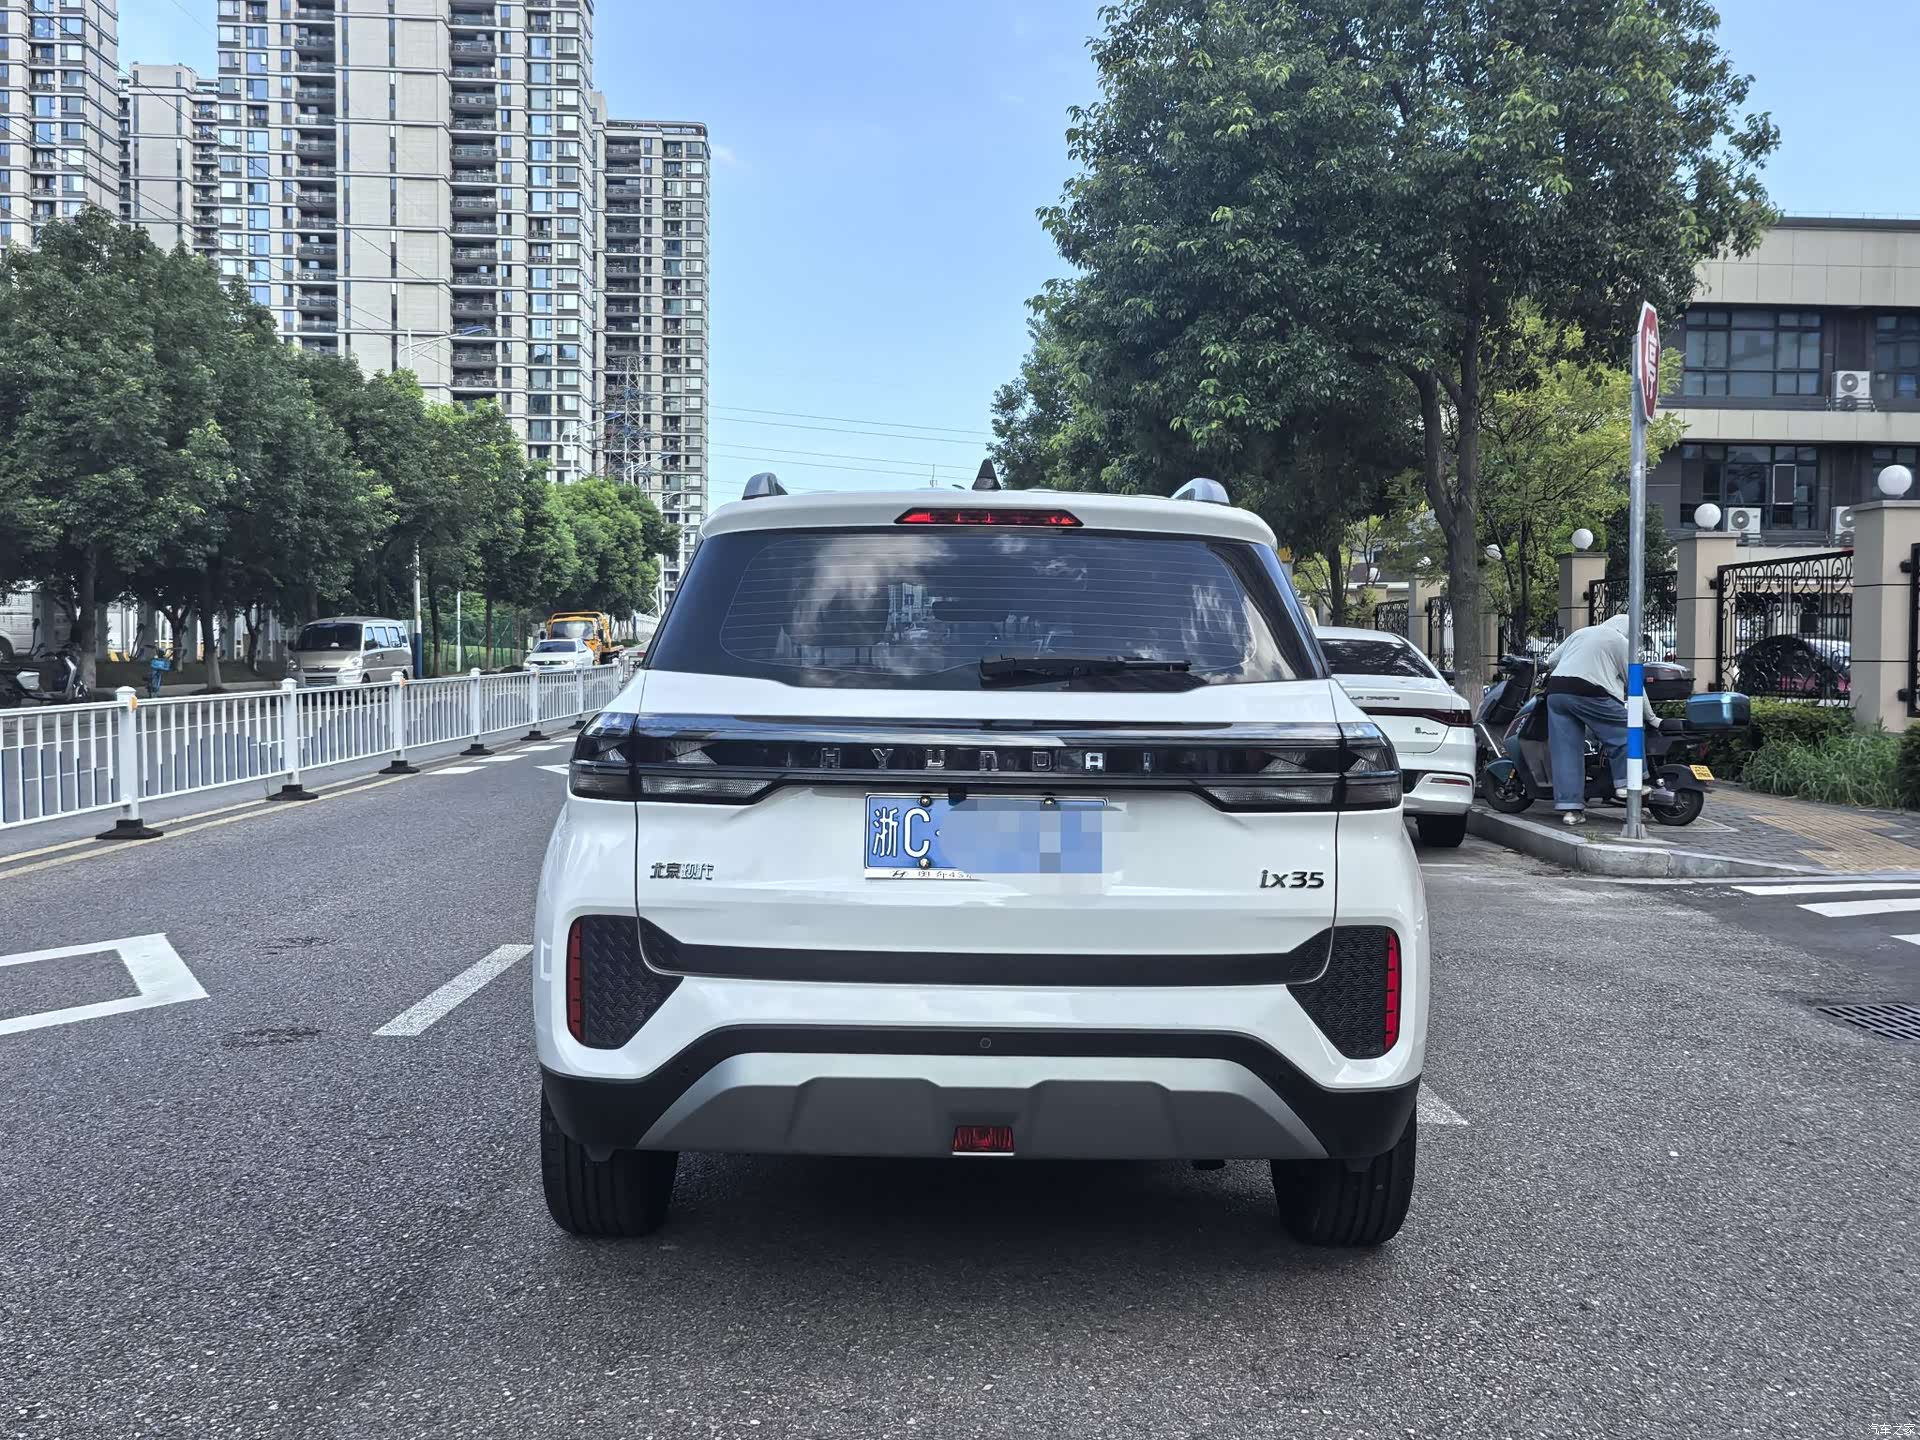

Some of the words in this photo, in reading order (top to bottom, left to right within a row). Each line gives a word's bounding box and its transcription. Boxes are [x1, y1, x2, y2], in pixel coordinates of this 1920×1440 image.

[819, 748, 1152, 772] HYUNDAI
[650, 862, 715, 881] 北京现代
[1260, 869, 1325, 889] ix35
